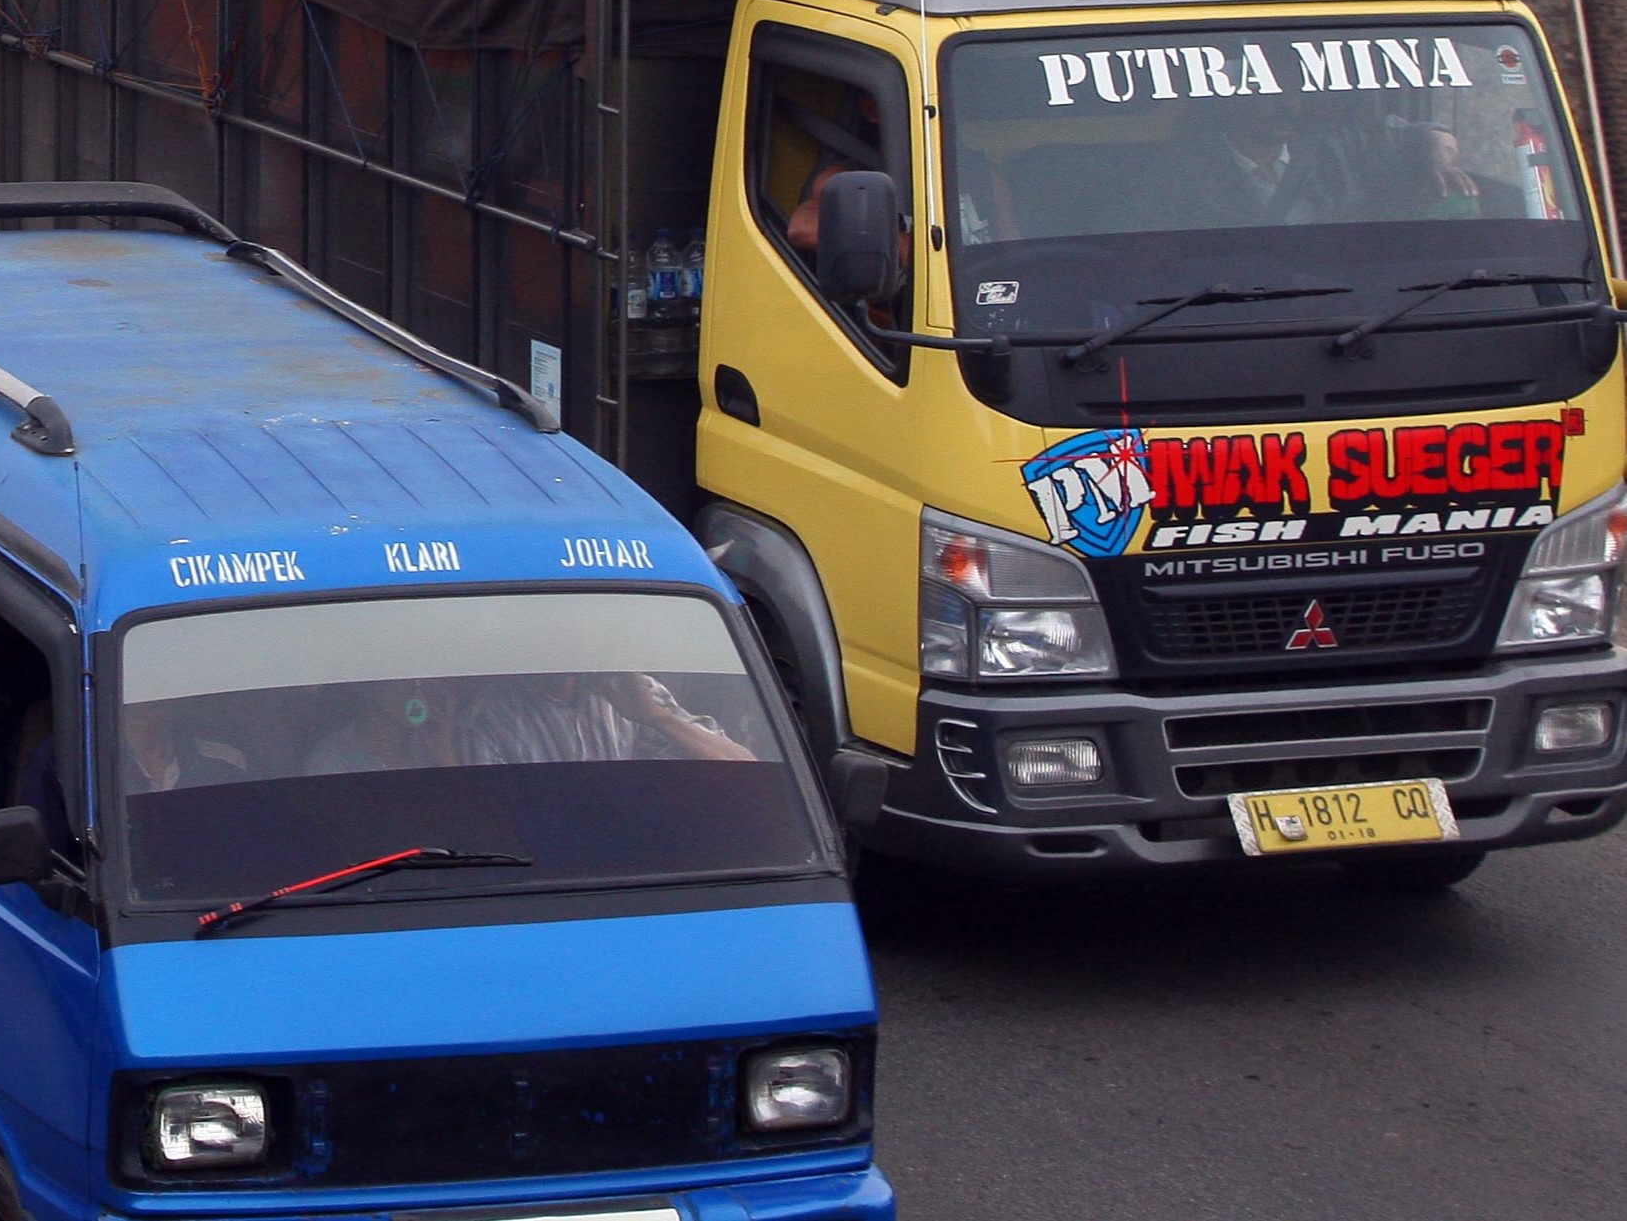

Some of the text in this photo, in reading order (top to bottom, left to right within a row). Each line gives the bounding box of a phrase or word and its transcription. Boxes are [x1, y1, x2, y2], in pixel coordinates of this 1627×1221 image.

[1039, 37, 1473, 106] PUTRA MINA
[1148, 433, 1309, 521] IWAK
[1327, 420, 1566, 510] SUEGER
[1152, 504, 1556, 548] FISH MANIA
[170, 538, 654, 588] CIKAMPEK KLARI JOHAR
[1144, 541, 1484, 576] MITSUBISHI FUSO
[1252, 799, 1276, 832] H
[1298, 792, 1368, 827] 1812
[1327, 827, 1376, 840] 01-18
